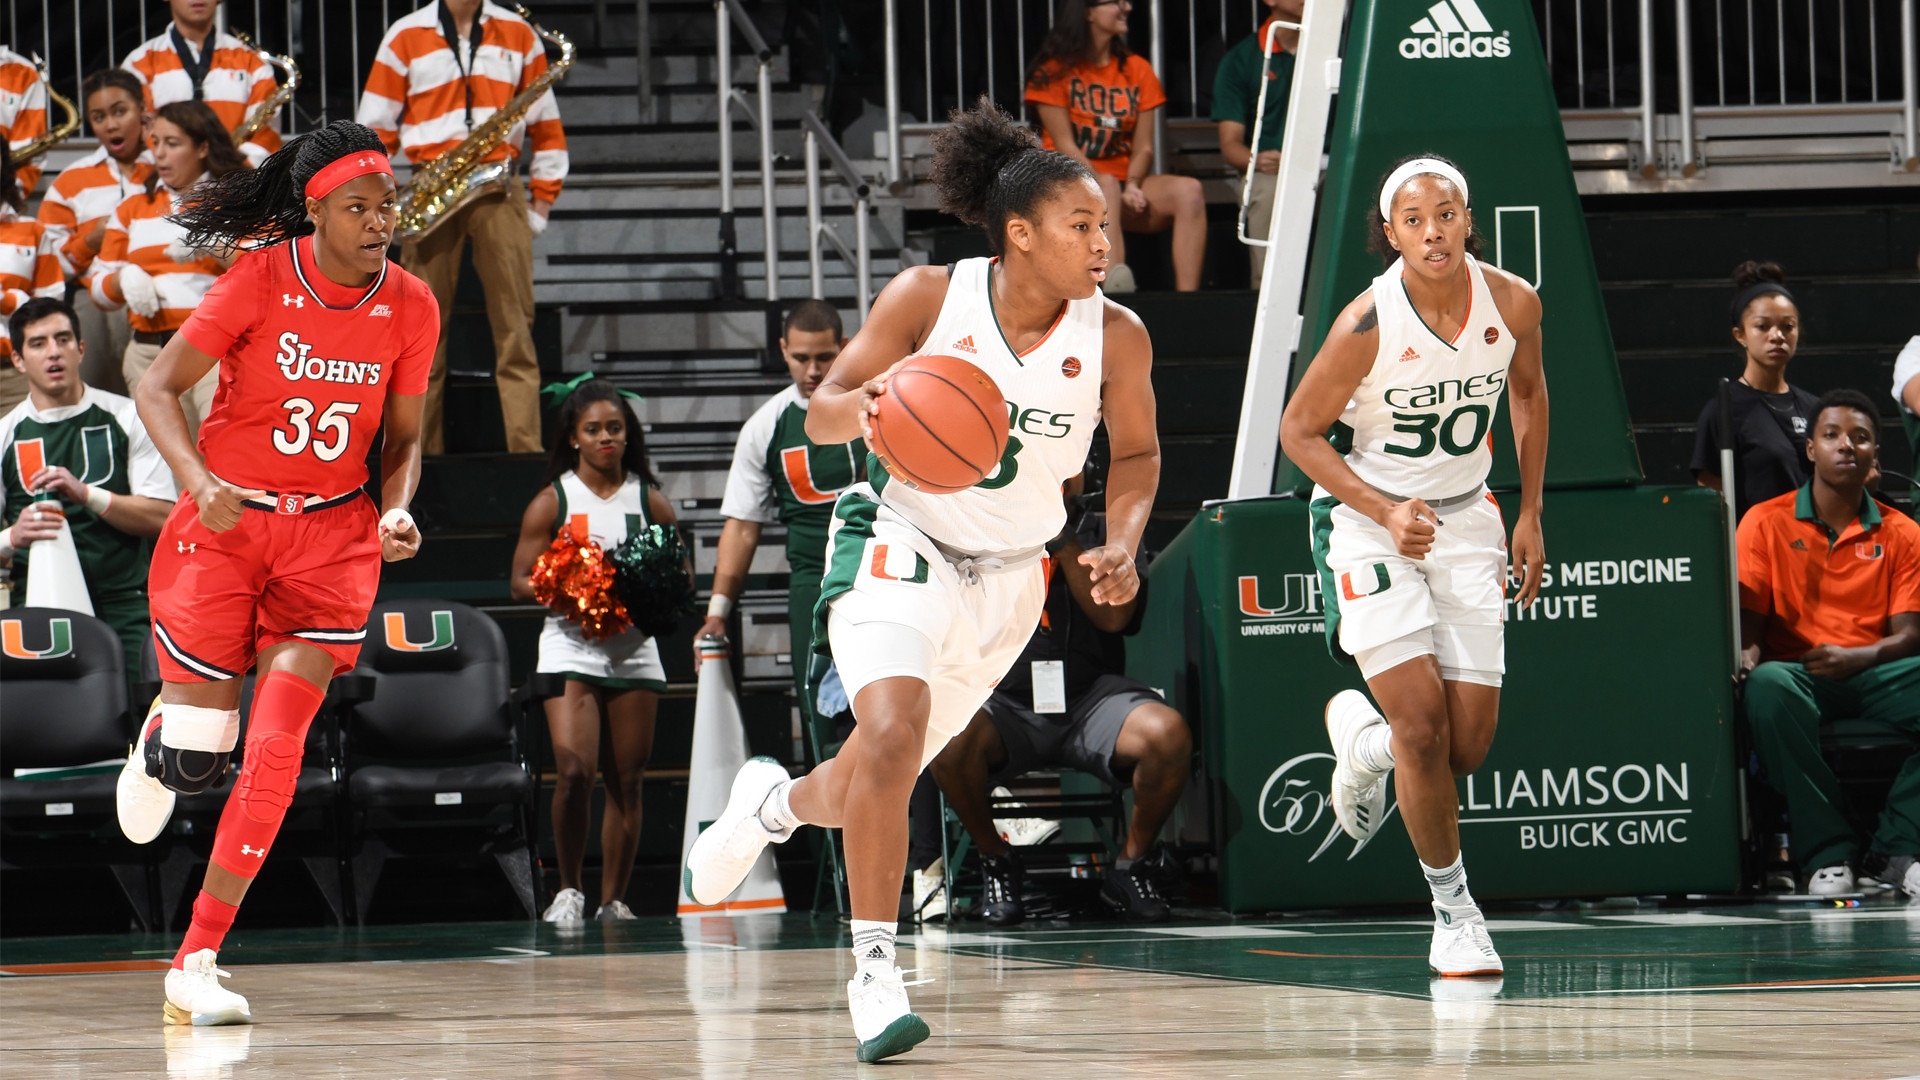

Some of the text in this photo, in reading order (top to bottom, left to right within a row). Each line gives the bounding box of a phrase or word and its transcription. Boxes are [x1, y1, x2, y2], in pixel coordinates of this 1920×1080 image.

[1399, 30, 1511, 59] adidas
[952, 342, 978, 354] adidas
[271, 396, 361, 462] 35
[1384, 404, 1490, 457] 30
[1561, 557, 1691, 587] MEDICINE
[1241, 623, 1296, 636] UNIVERSITY
[1299, 624, 1312, 633] OF
[1520, 819, 1688, 850] BUICK GMC
